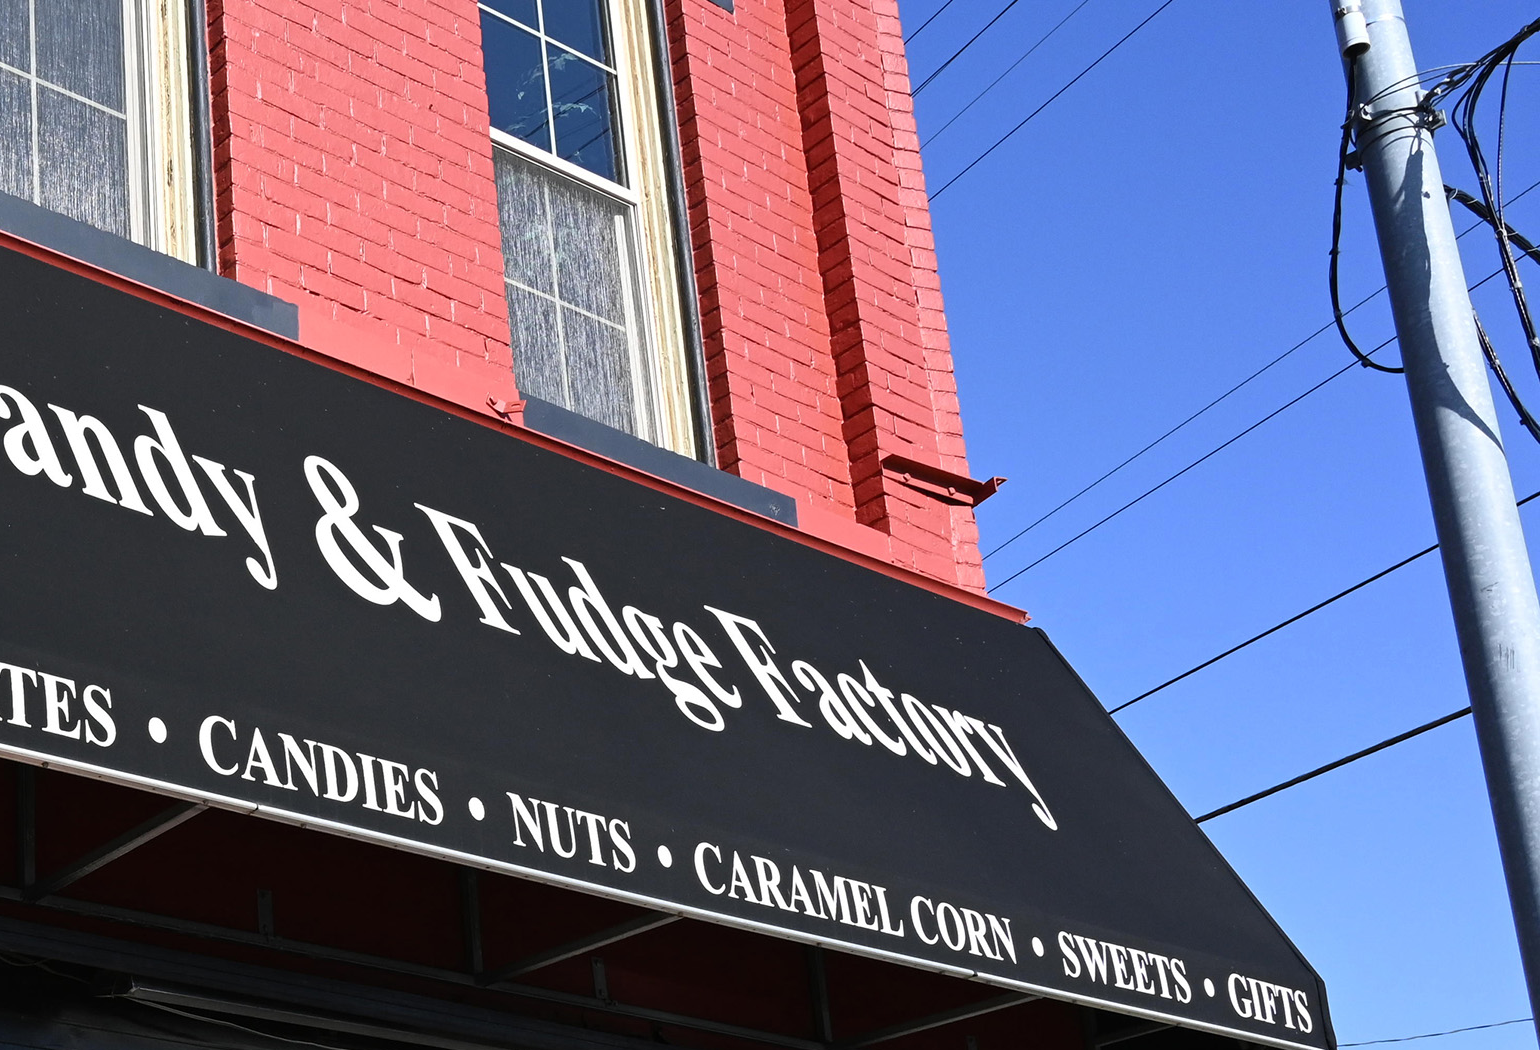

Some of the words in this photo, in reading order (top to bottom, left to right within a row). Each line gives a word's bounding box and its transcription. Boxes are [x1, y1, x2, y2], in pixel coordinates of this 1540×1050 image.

[304, 455, 442, 623] &
[414, 502, 742, 732] Fudge
[704, 605, 1058, 831] Factory
[199, 715, 445, 826] CANDIES
[506, 792, 637, 873] NUTS
[694, 842, 905, 938] CARAMEL
[911, 896, 1017, 965] CORN
[1058, 930, 1192, 1004] SWEETS
[1227, 973, 1314, 1034] GIFTS
